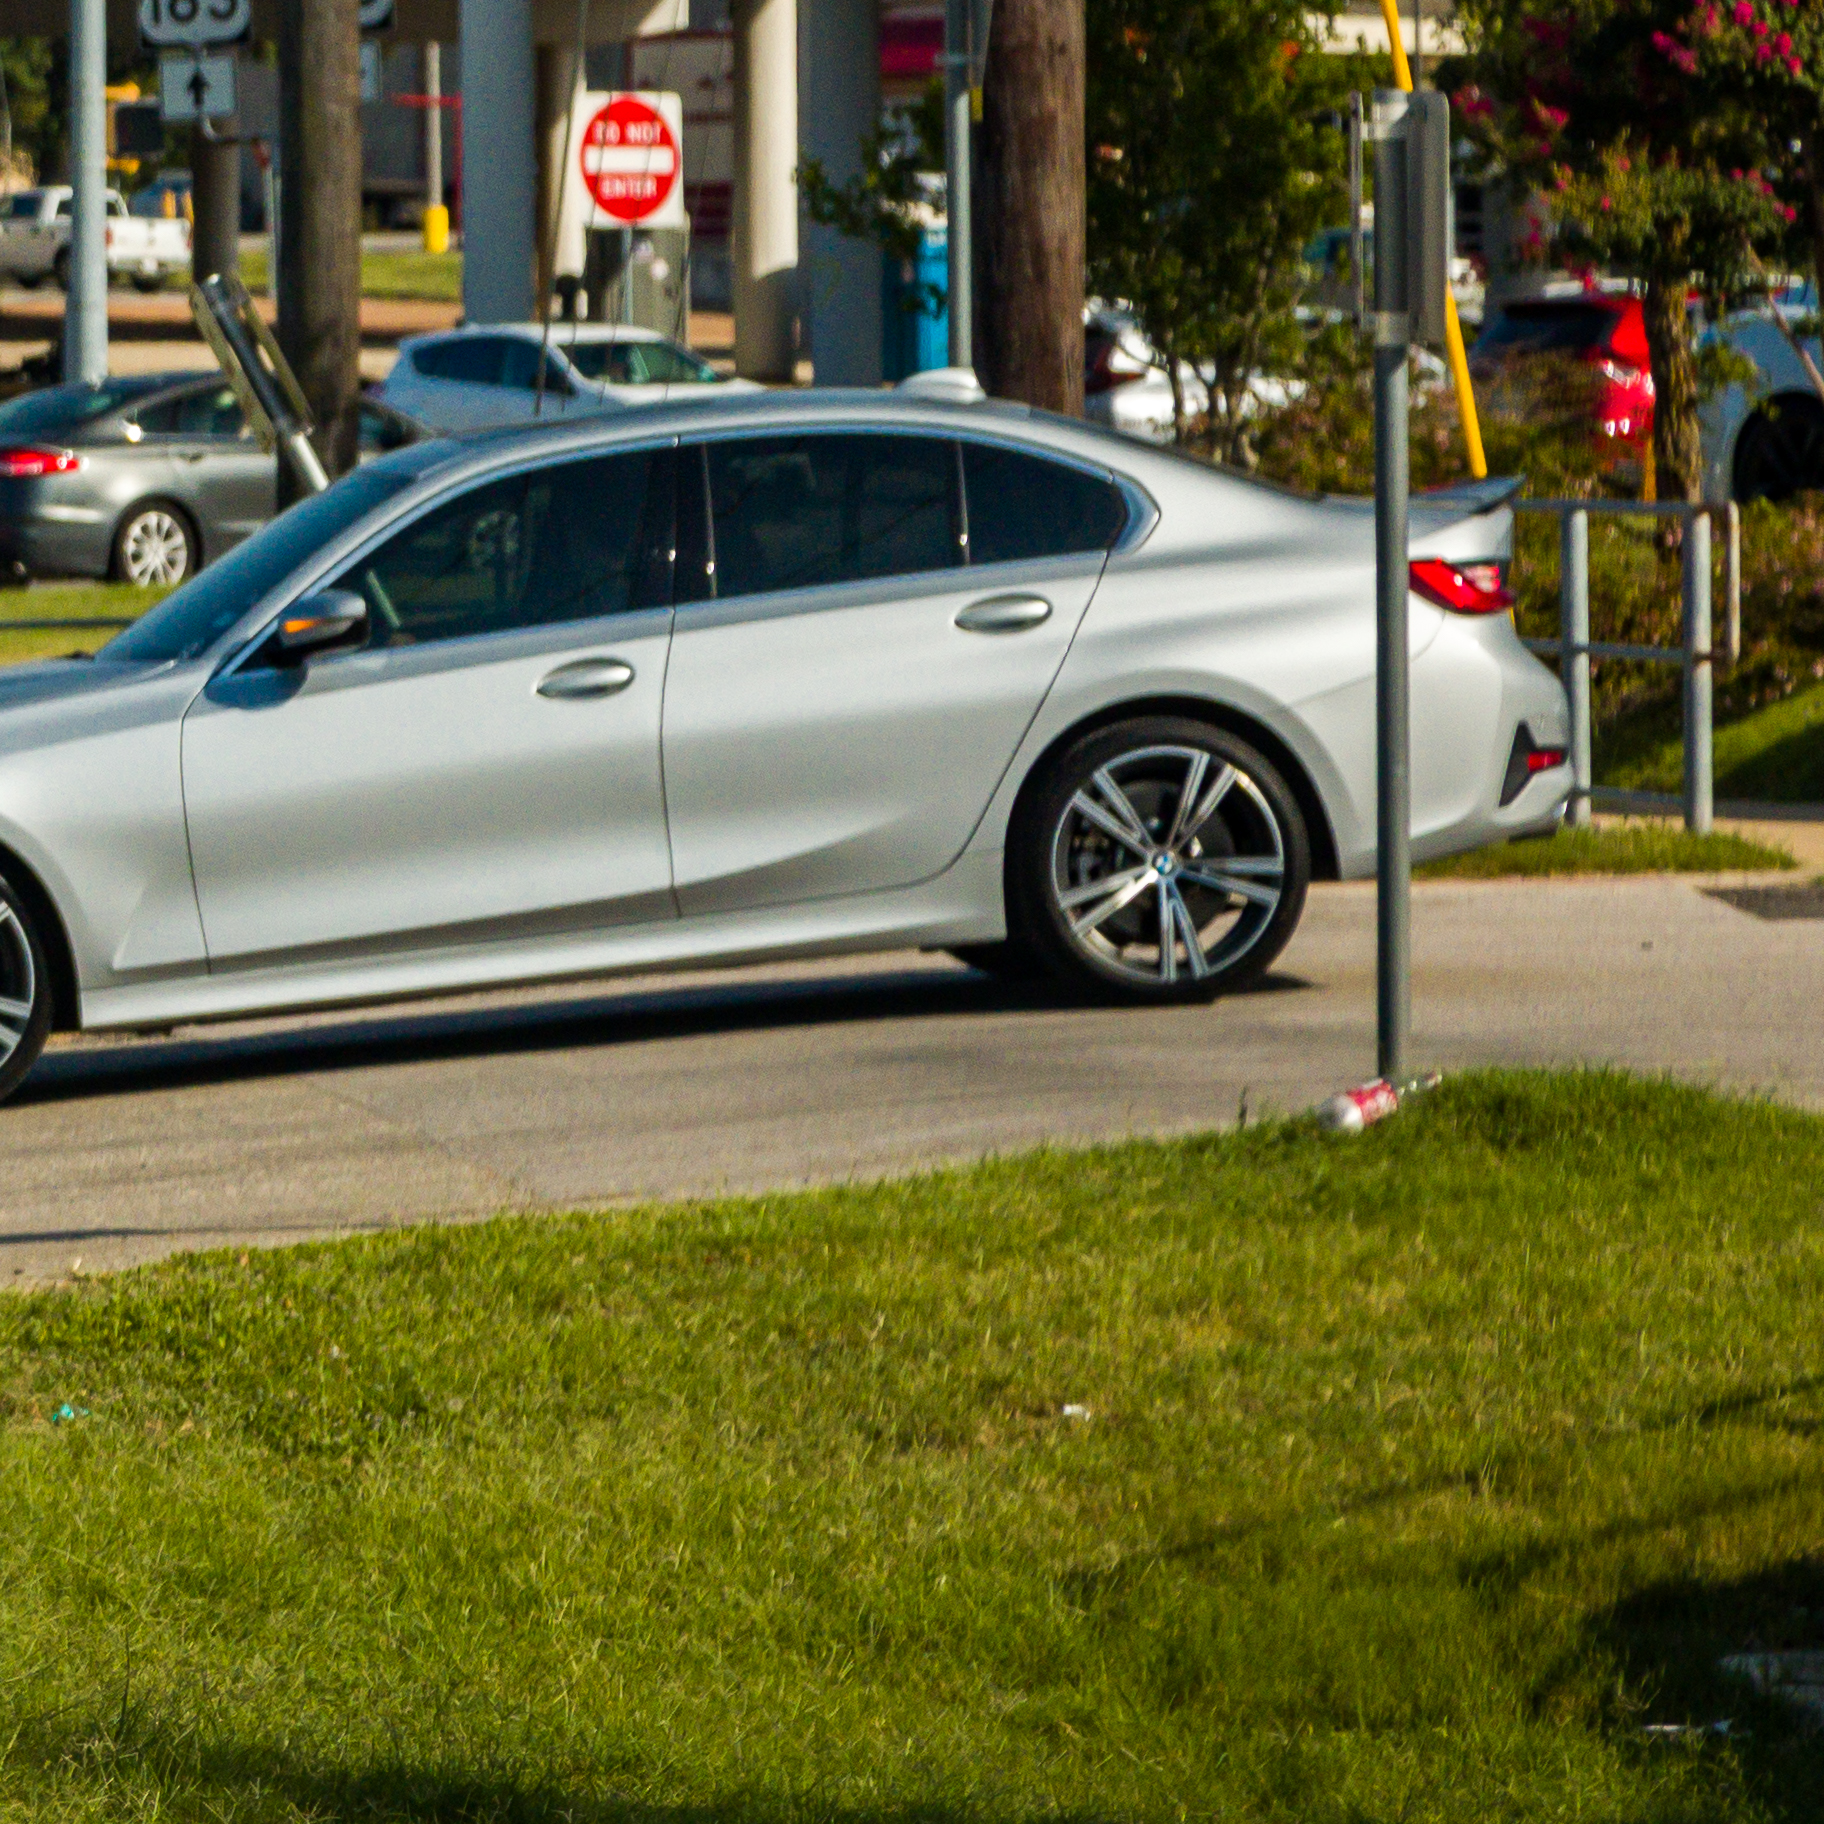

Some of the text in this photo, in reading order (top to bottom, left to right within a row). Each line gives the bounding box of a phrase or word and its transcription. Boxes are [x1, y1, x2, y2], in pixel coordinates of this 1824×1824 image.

[591, 119, 662, 145] DO NOT
[597, 175, 659, 201] ENTER
